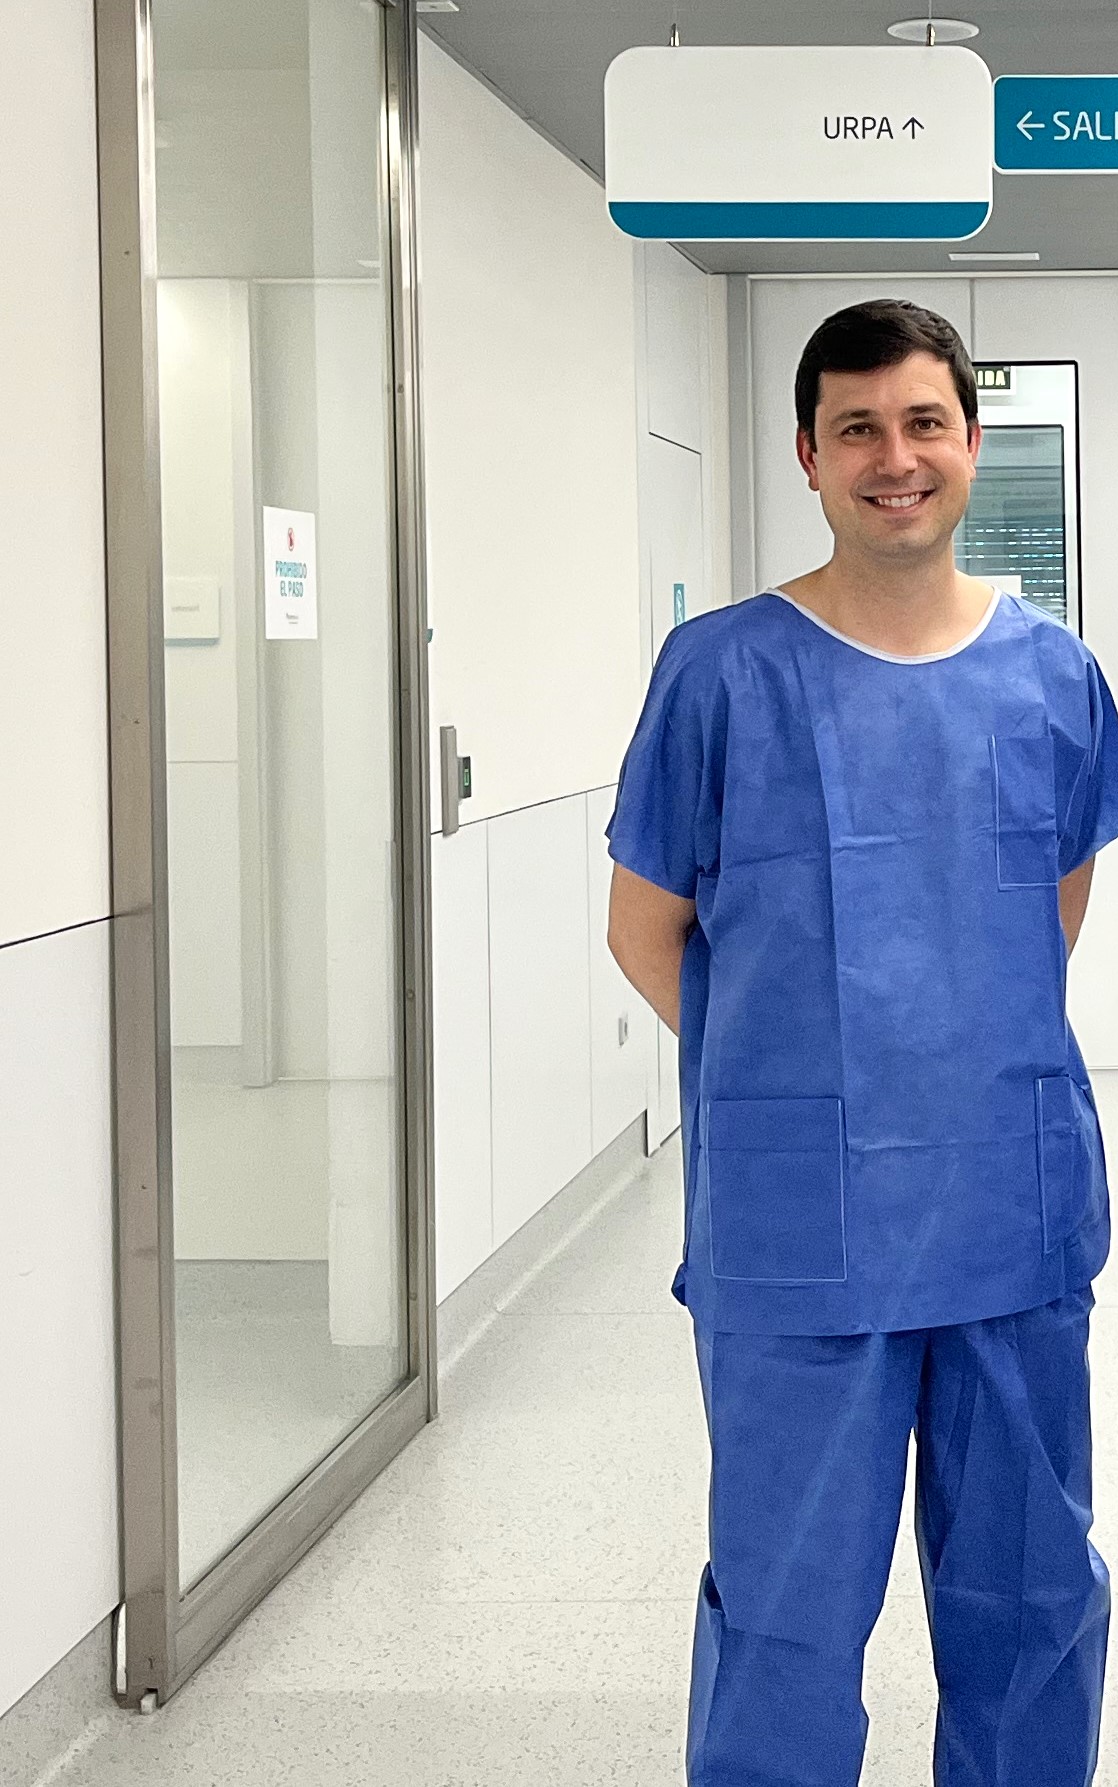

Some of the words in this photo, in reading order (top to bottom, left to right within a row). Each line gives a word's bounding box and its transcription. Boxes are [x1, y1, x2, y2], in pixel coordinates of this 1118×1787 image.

[823, 116, 894, 140] URPA
[275, 560, 308, 579] PROHIBIDO
[280, 580, 288, 597] EL
[288, 580, 304, 598] PASO
